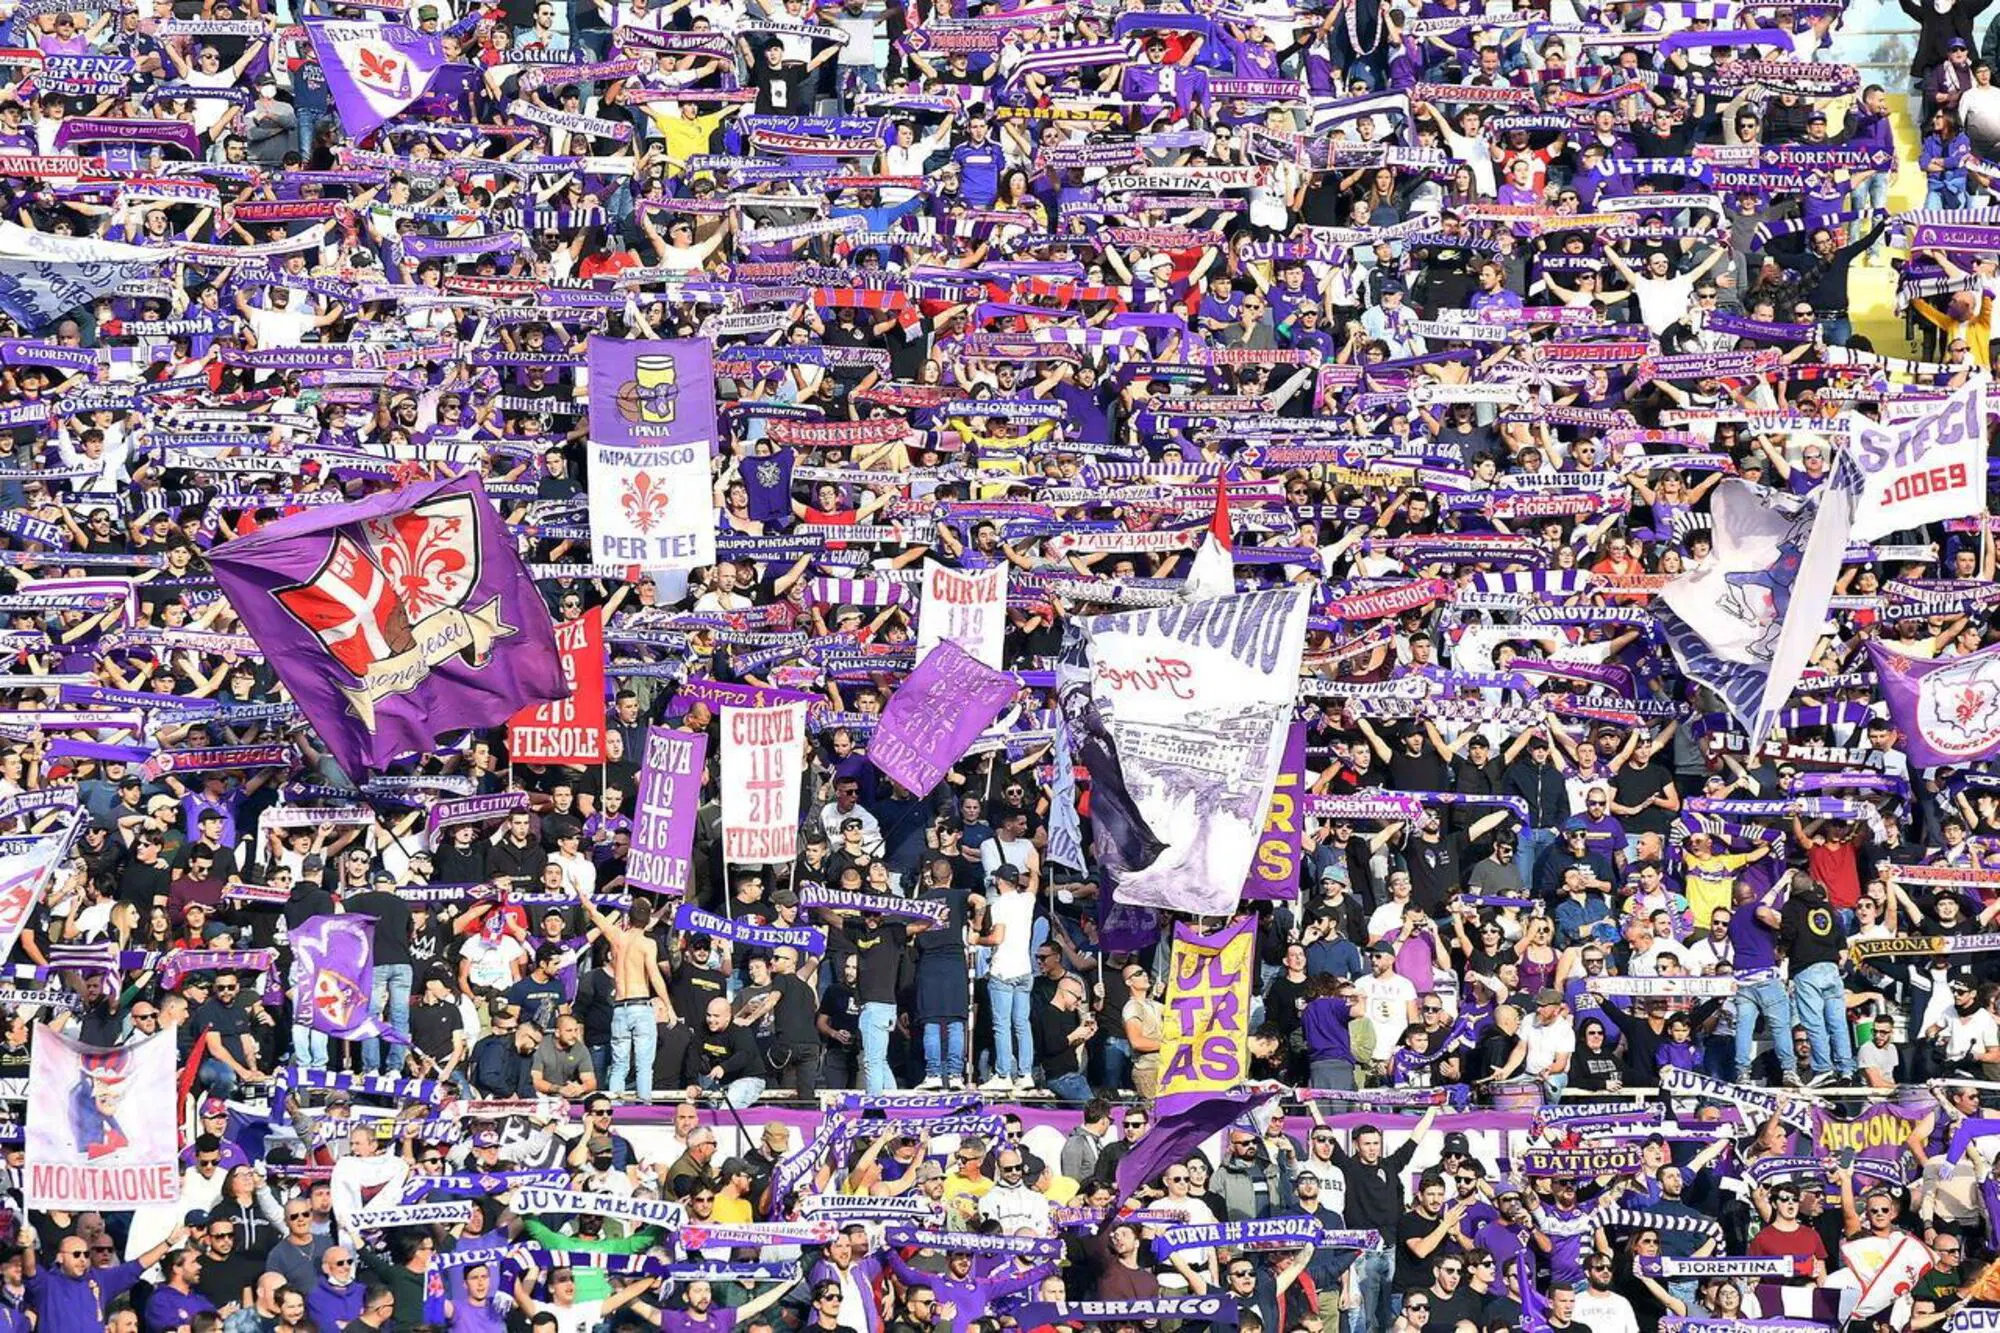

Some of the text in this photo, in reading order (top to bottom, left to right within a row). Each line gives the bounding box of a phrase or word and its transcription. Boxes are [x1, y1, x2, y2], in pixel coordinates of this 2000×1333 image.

[750, 21, 831, 37] FIORENTINA
[501, 50, 575, 64] FIORENTINA
[1434, 86, 1522, 100] FIORENTINA
[1780, 150, 1871, 164] FIORENTINA
[1597, 157, 1704, 176] ULTRAS
[1108, 177, 1211, 193] FIORENTINA
[1713, 170, 1804, 187] FIORENTINA
[433, 235, 500, 249] FIORENTINA
[848, 231, 932, 247] FIORENTINA
[121, 321, 213, 336] FIORENTINA
[1471, 325, 1503, 340] REAL
[242, 352, 330, 366] FIORENTINA
[496, 352, 580, 363] FIORENTINA
[1158, 367, 1206, 377] FIORENTINA
[749, 407, 807, 417] FIORENTINA
[1753, 417, 1802, 434] JUVE
[158, 431, 259, 447] FIORENTINA
[792, 427, 884, 443] FIORENTINA
[179, 457, 284, 471] FIORENTINA
[598, 447, 695, 468] IMPAZZISCO
[1516, 474, 1605, 488] FIORENTINA
[1181, 486, 1269, 496] FIORNTINA
[1516, 501, 1594, 515] FIORENTINA
[603, 533, 697, 560] PER TE!
[760, 537, 822, 550] PINTASPORT
[932, 569, 998, 605] CURVA
[1576, 695, 1681, 713] FIORENTINA
[731, 709, 795, 747] CURVA
[512, 726, 599, 758] FIESOLE
[1786, 746, 1884, 770] MERDA
[450, 796, 520, 815] COLLETTIVO
[1314, 800, 1401, 814] FIORENTINA
[725, 823, 797, 859] FIESOLE
[690, 910, 811, 948] CURVA FIESOLE
[1859, 940, 1930, 954] VERONA
[1668, 1069, 1728, 1095] JUVE
[1540, 1109, 1575, 1123] CIAO
[1531, 1151, 1640, 1170] BATIGOL
[32, 1163, 175, 1201] MONTAIONE
[517, 1187, 683, 1229] JUVE MERDA
[820, 1195, 919, 1210] FIORENTINA
[1165, 1216, 1320, 1246] CURVA FIESOLE
[1676, 1259, 1778, 1275] FIORENTINA
